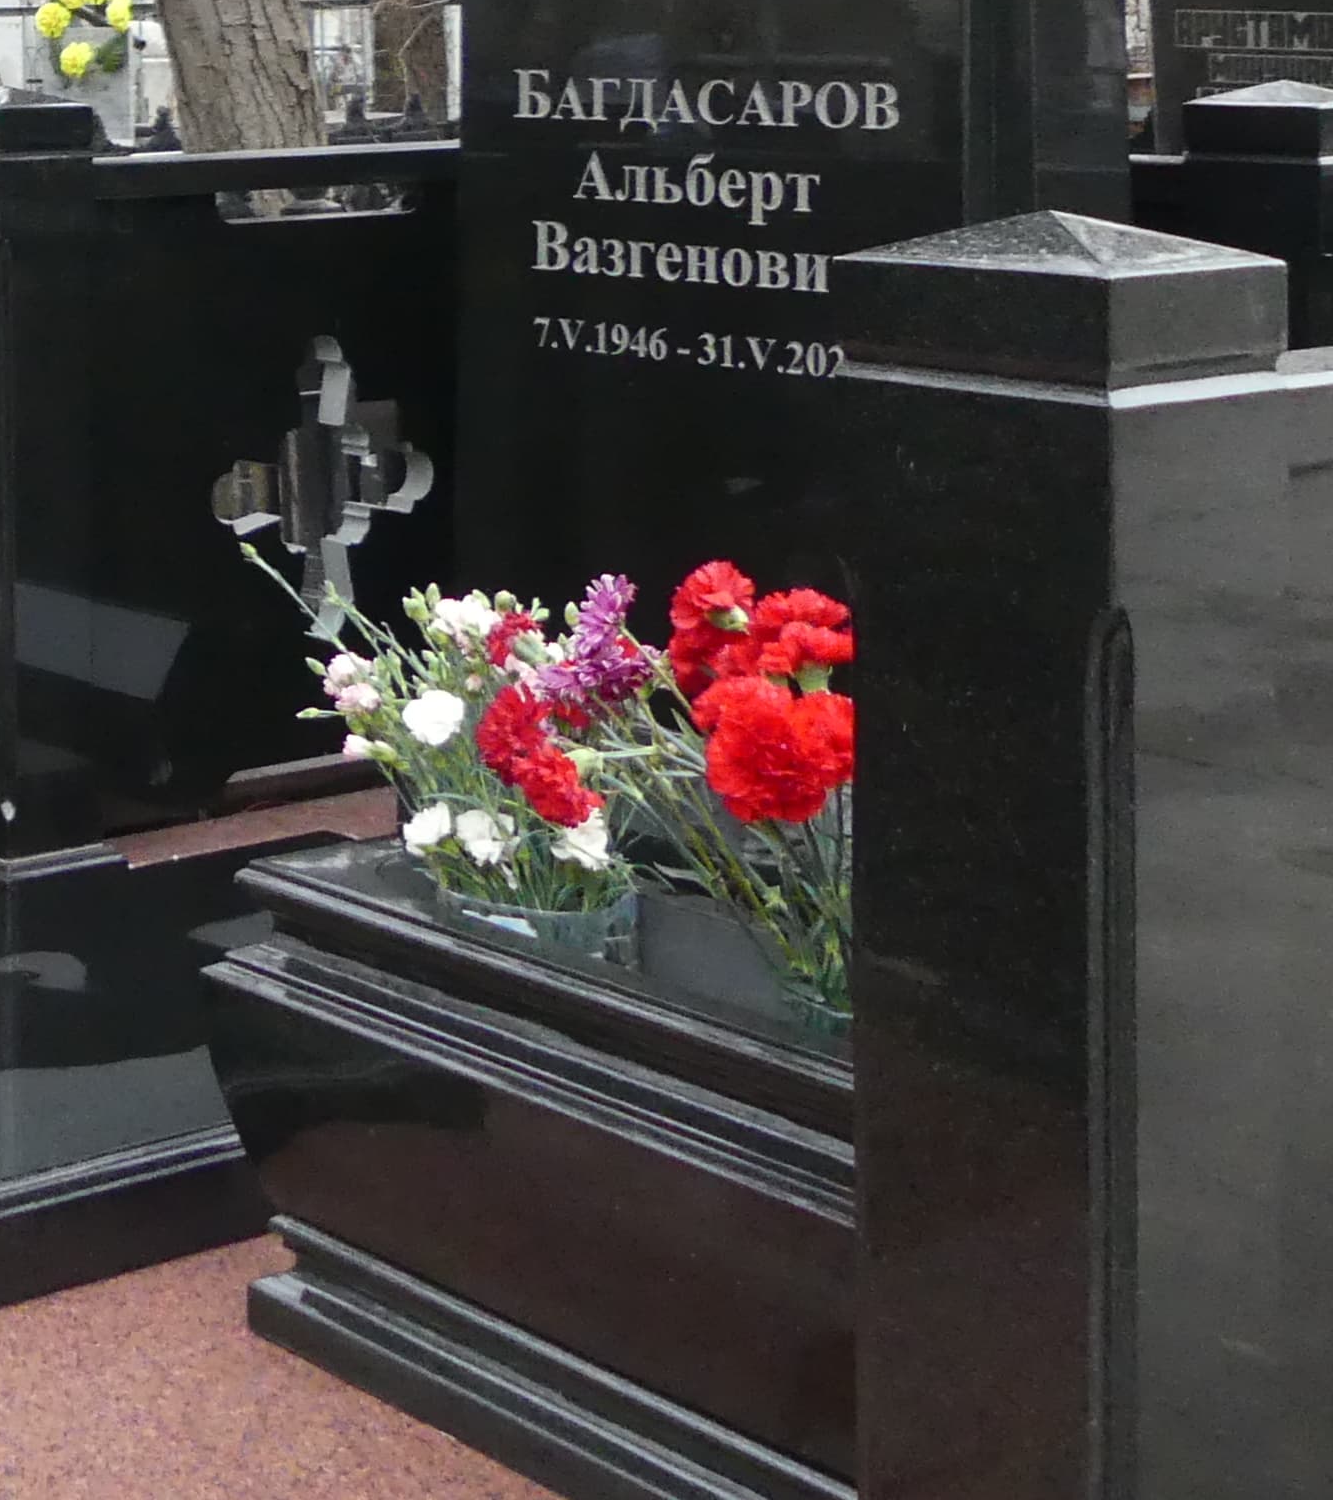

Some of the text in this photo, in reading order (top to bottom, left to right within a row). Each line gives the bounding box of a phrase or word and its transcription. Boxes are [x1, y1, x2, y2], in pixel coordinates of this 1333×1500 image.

[513, 68, 900, 133] БАГДАСАРОВ
[573, 151, 821, 226] Альберт
[531, 220, 831, 293] Вазгенови
[533, 317, 667, 361] 7.V.1946
[696, 332, 845, 378] 31.V.202
